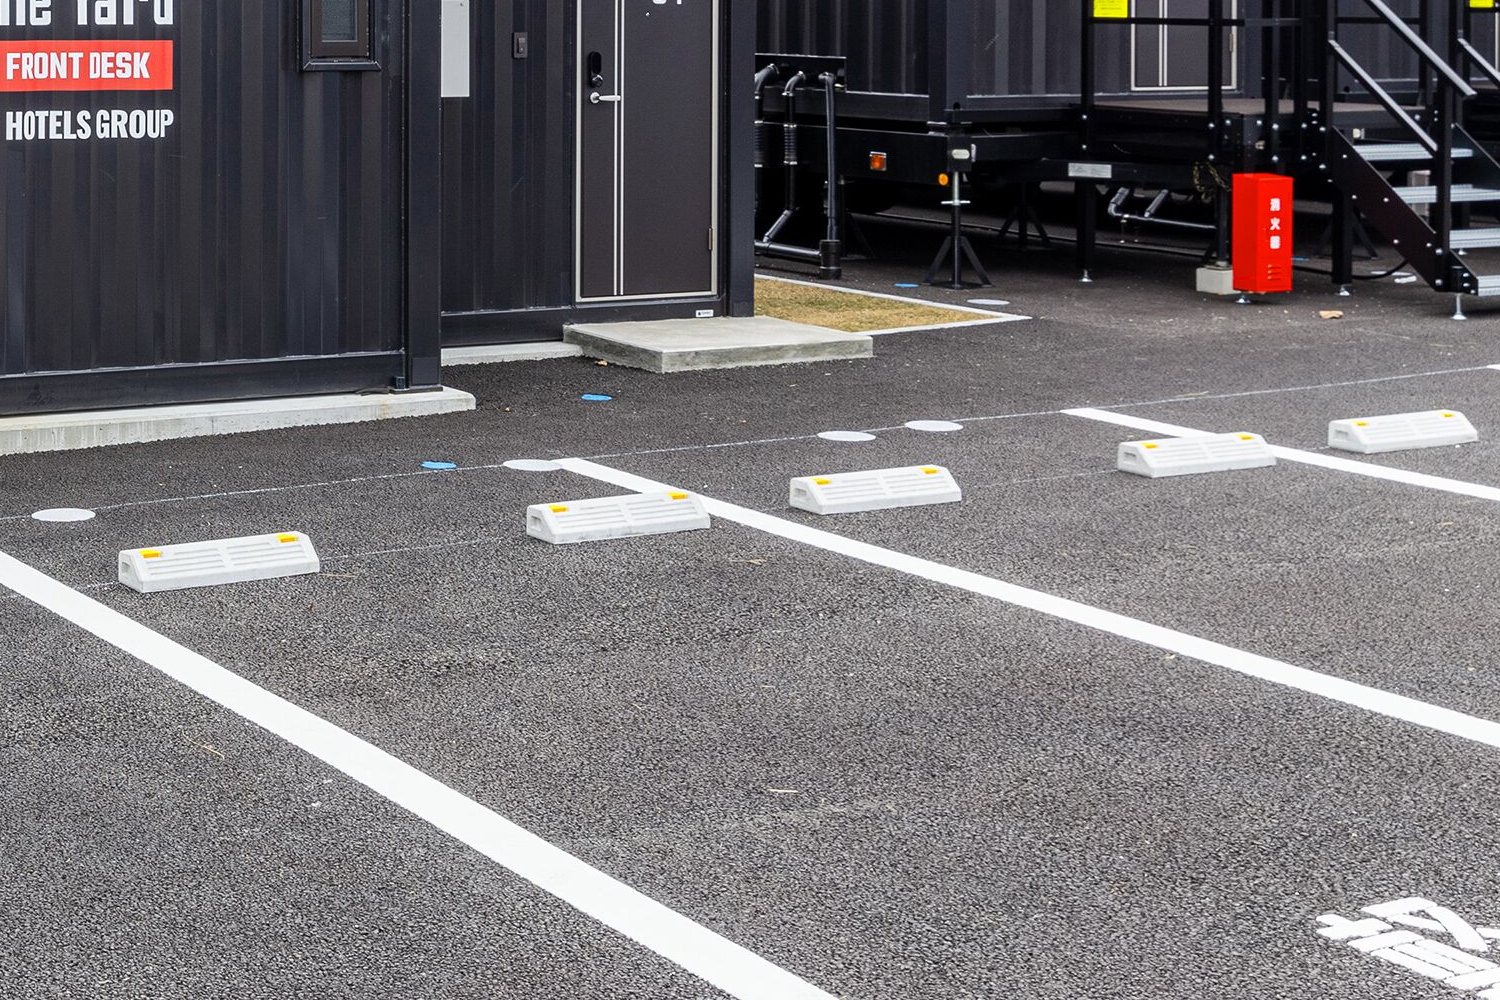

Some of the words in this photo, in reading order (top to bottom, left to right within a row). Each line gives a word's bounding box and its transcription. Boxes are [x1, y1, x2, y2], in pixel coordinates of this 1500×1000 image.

[6, 52, 84, 80] FRONT
[89, 52, 150, 79] DESK
[6, 110, 91, 140] HOTELS
[96, 109, 174, 139] GROUP
